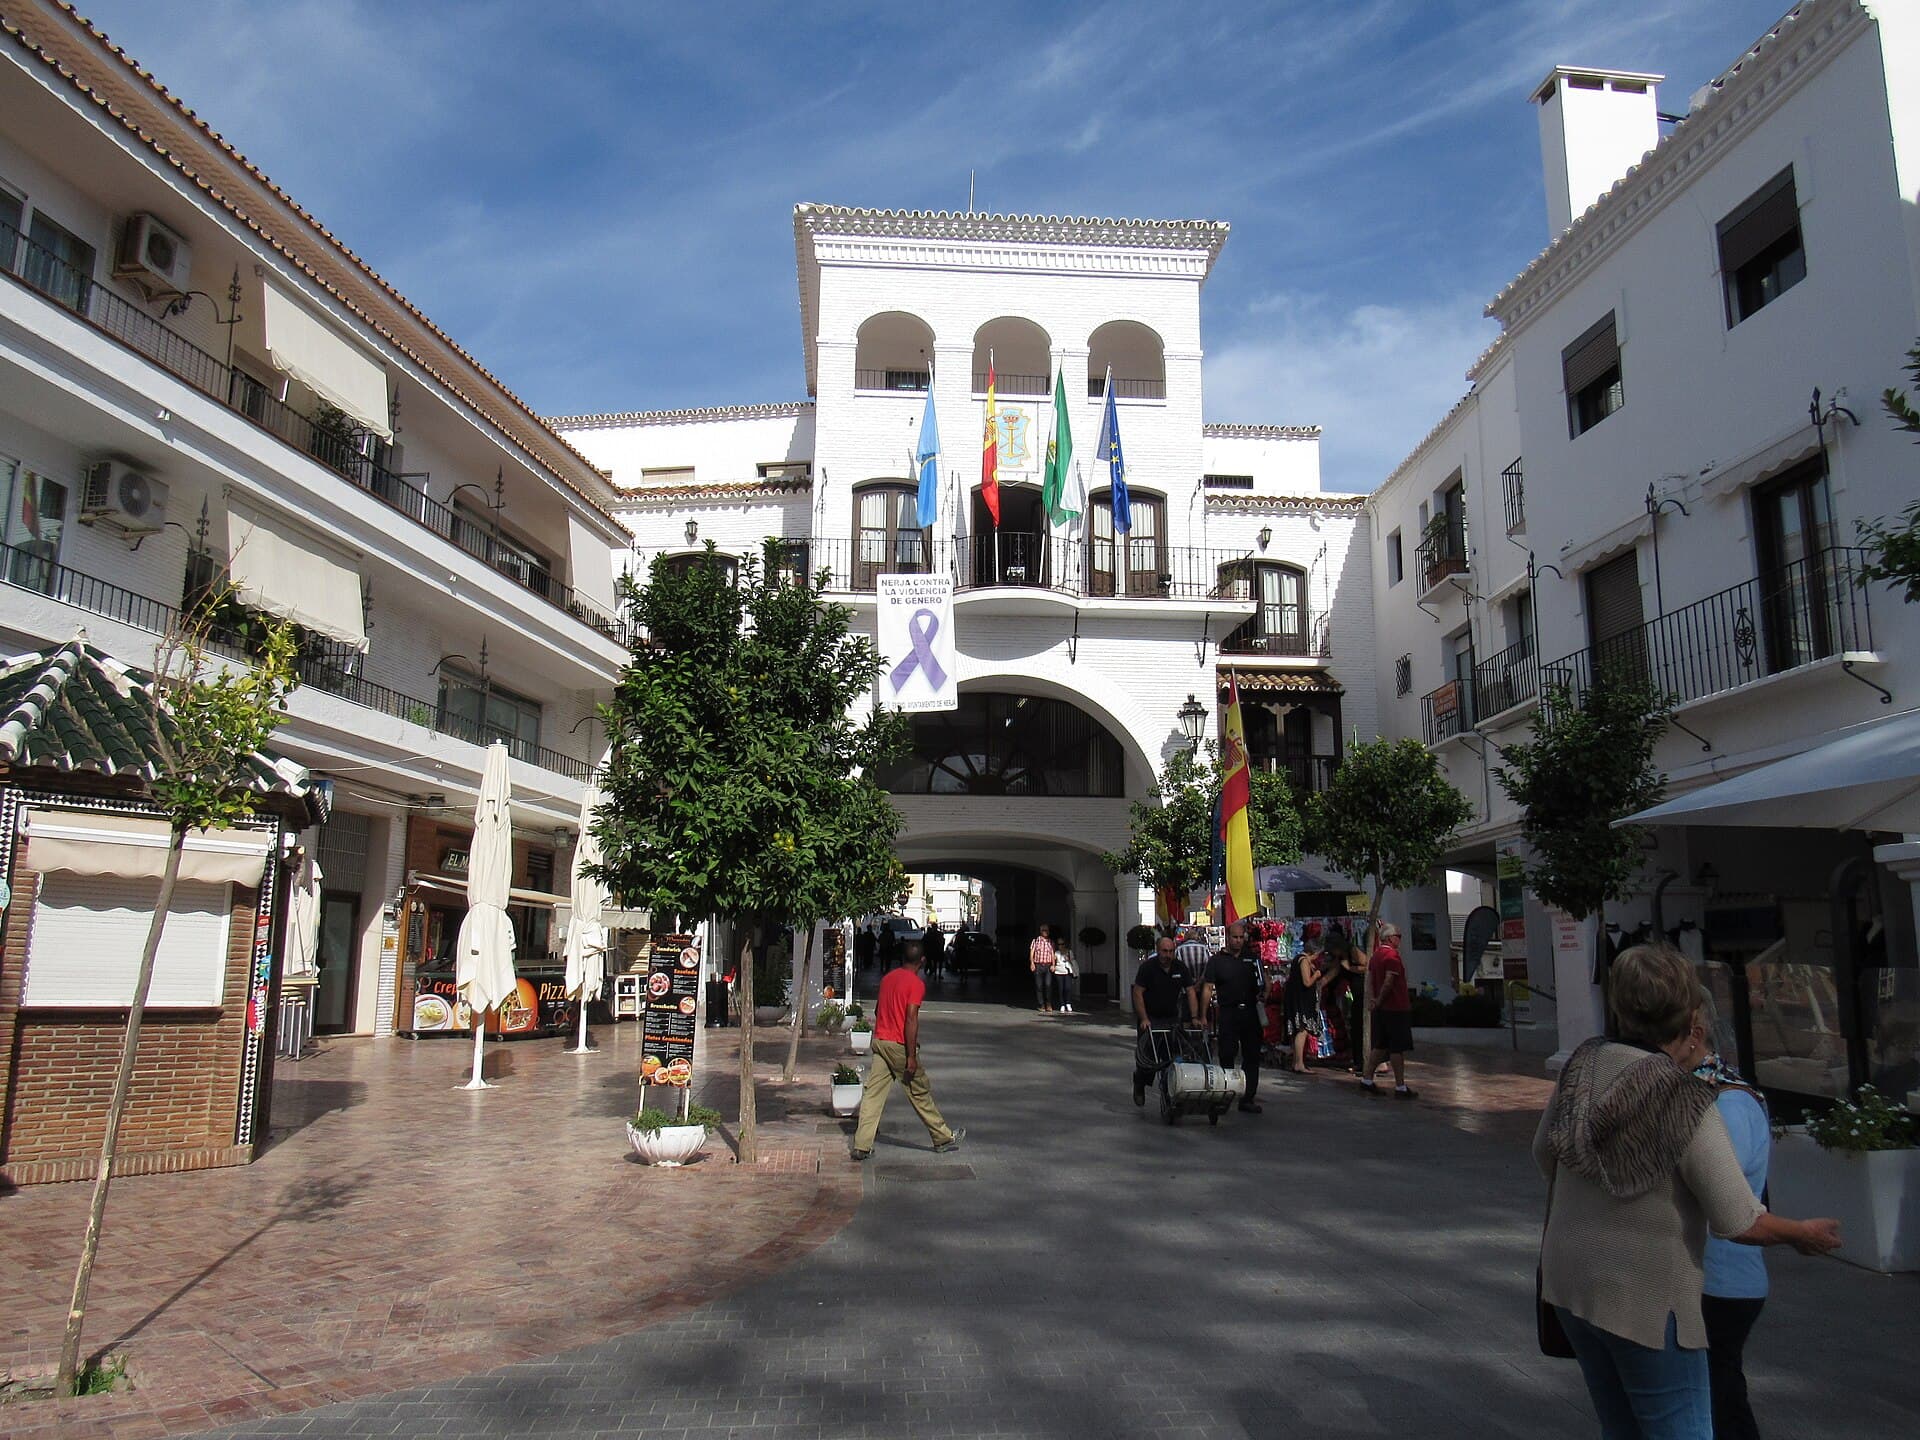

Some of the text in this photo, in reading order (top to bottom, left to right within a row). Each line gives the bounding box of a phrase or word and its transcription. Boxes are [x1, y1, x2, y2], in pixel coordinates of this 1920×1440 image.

[881, 578, 951, 587] NERJA CONTRA
[885, 587, 947, 596] LA VIOLENCIA
[890, 597, 903, 605] DE
[447, 853, 459, 867] EL
[254, 989, 266, 1033] Skittles
